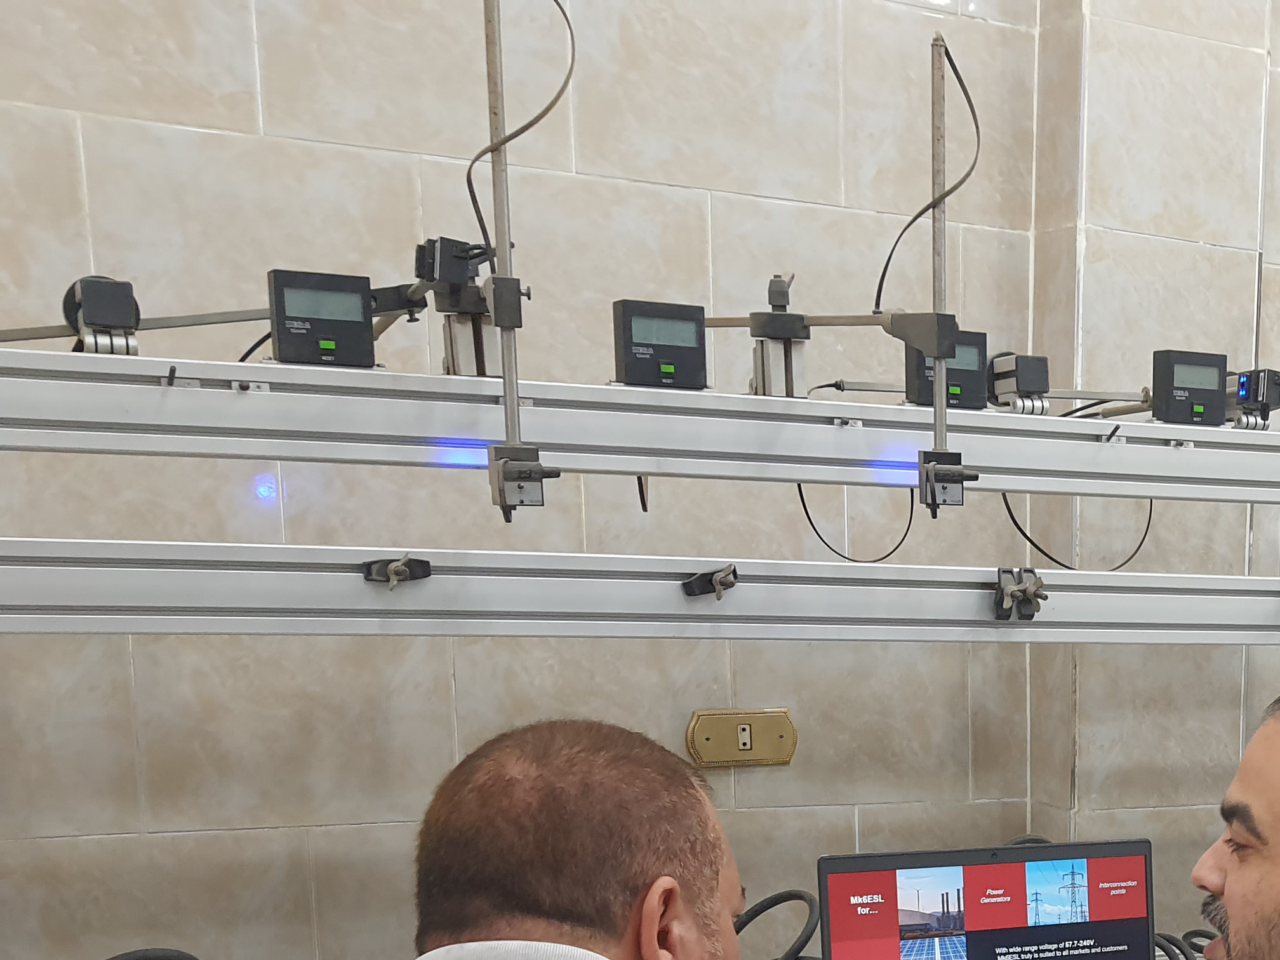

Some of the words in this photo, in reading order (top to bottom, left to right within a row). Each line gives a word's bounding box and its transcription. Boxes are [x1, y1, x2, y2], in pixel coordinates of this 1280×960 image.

[986, 888, 1005, 896] Power
[850, 894, 885, 904] Mk6ESL
[857, 906, 878, 915] for...
[995, 946, 1008, 954] With
[1009, 945, 1021, 953] wide
[1038, 943, 1058, 951] voltage
[1020, 952, 1032, 960] truly
[1039, 950, 1055, 958] suited
